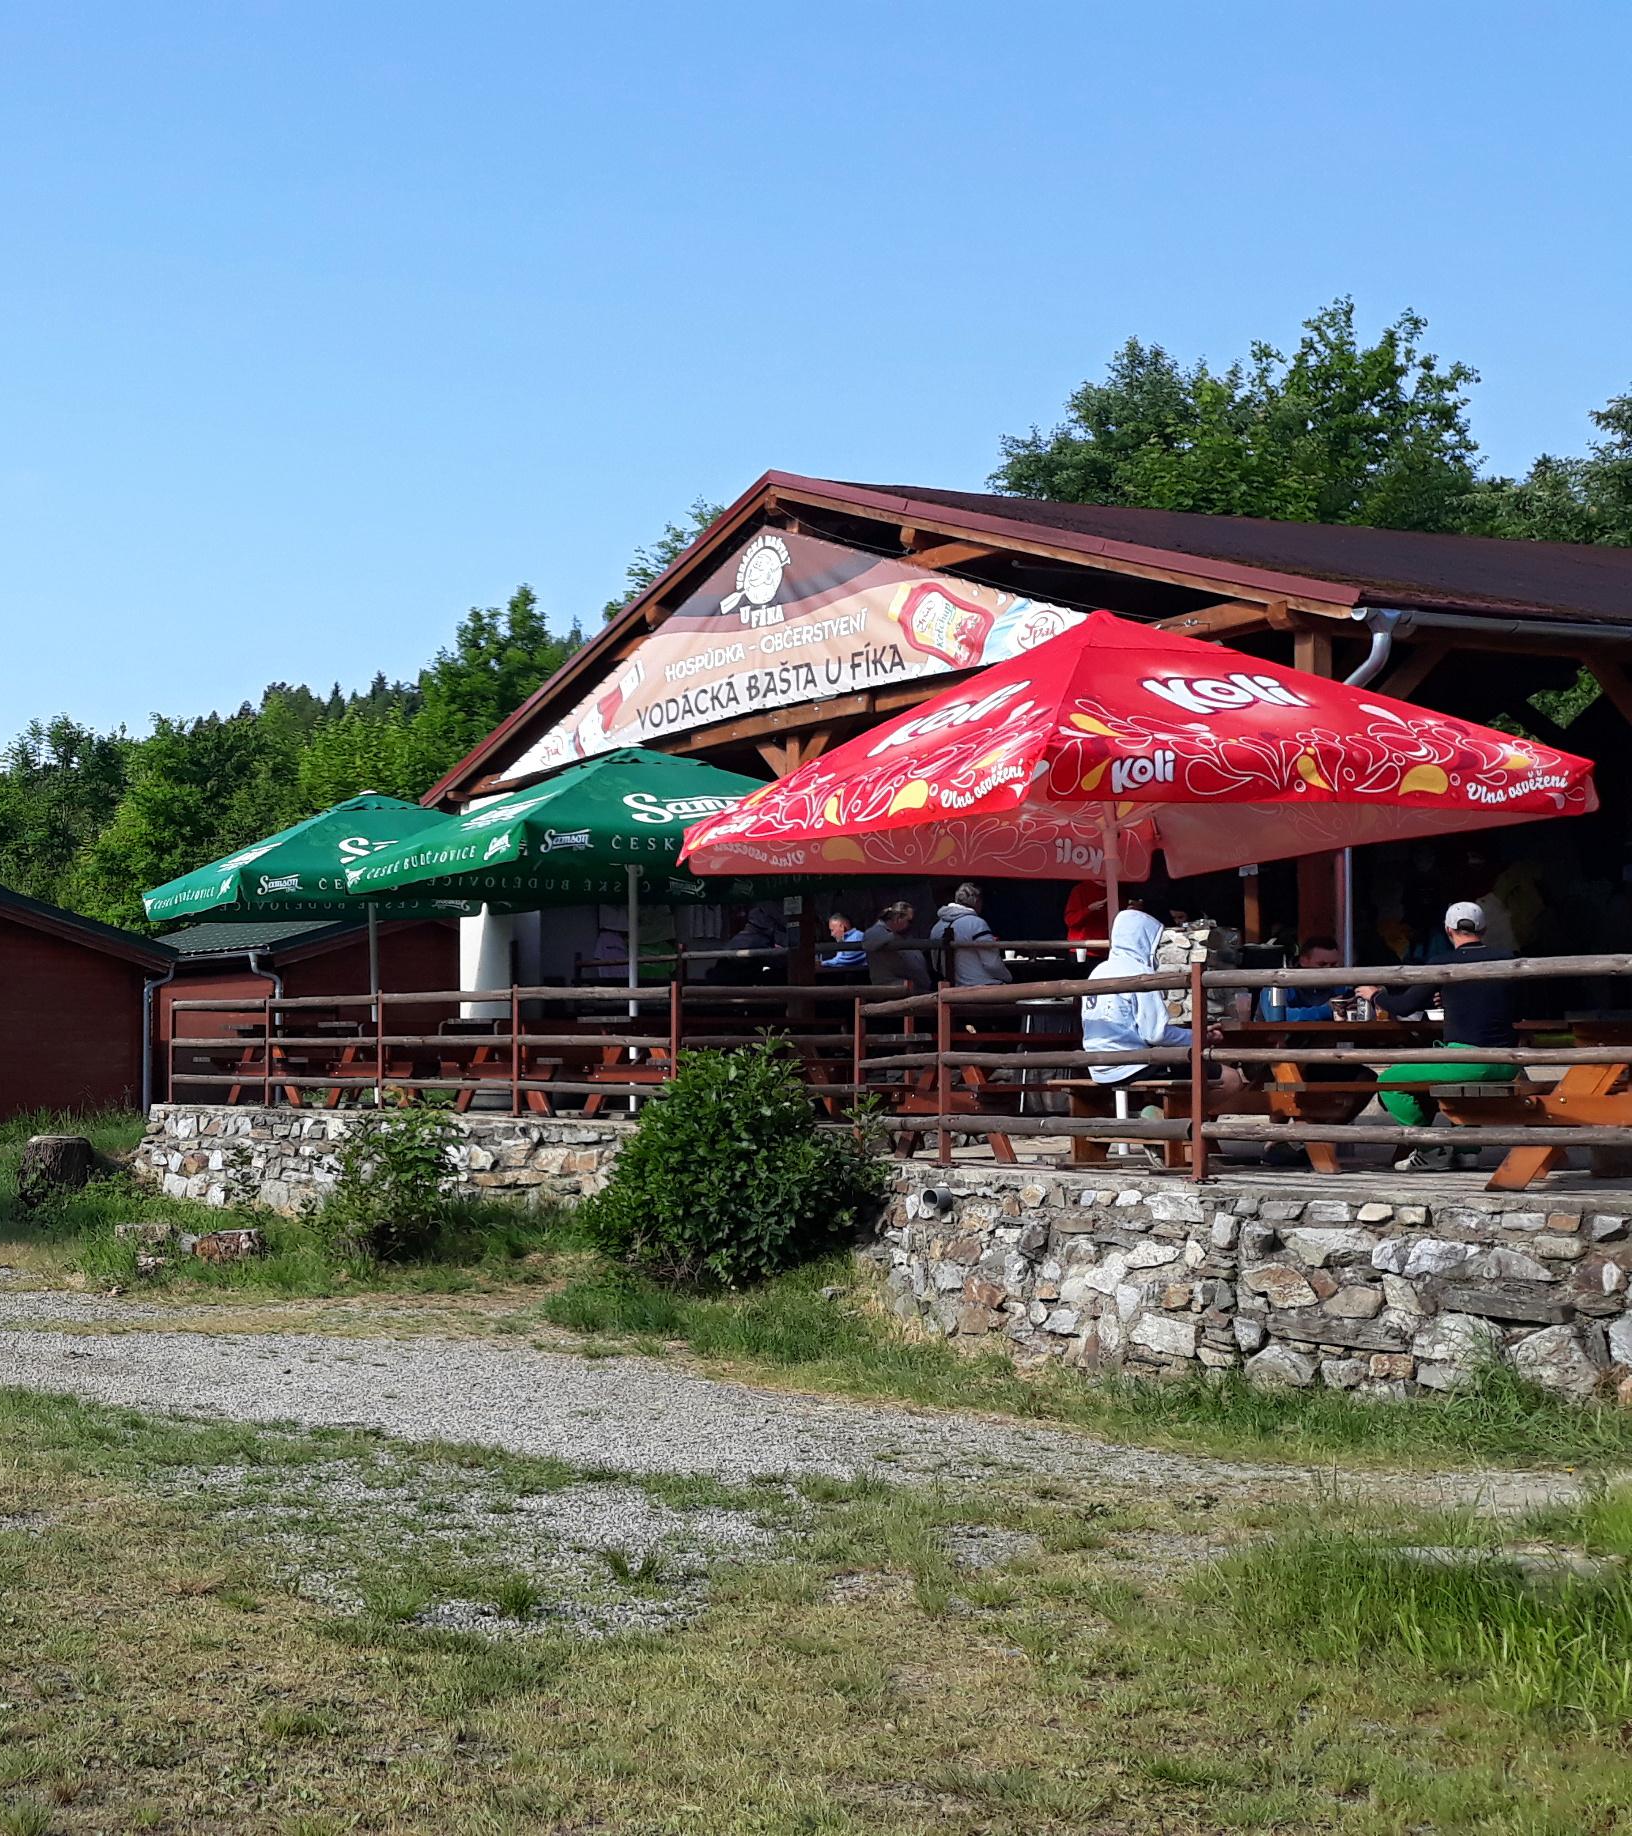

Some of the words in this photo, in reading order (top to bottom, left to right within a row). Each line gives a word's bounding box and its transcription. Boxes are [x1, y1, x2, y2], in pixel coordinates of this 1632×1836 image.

[739, 605, 751, 624] U
[751, 604, 785, 628] FÍKA
[664, 643, 745, 683] HOSPŮDKA
[760, 607, 868, 654] OBČERSTVENÍ
[636, 674, 740, 731] VODÁCKÁ
[746, 660, 817, 702] BAŠTA
[825, 656, 842, 685] U
[850, 641, 906, 681] FÍKA
[1141, 673, 1311, 715] Koli
[940, 789, 975, 808] Vlna
[973, 758, 1025, 799] osvěžení
[1111, 749, 1176, 794] Koli
[1466, 782, 1508, 804] Vlna
[1508, 769, 1569, 799] osvěžení
[539, 828, 594, 853] Samson
[611, 835, 676, 850] ČESK
[257, 873, 304, 896] Samson
